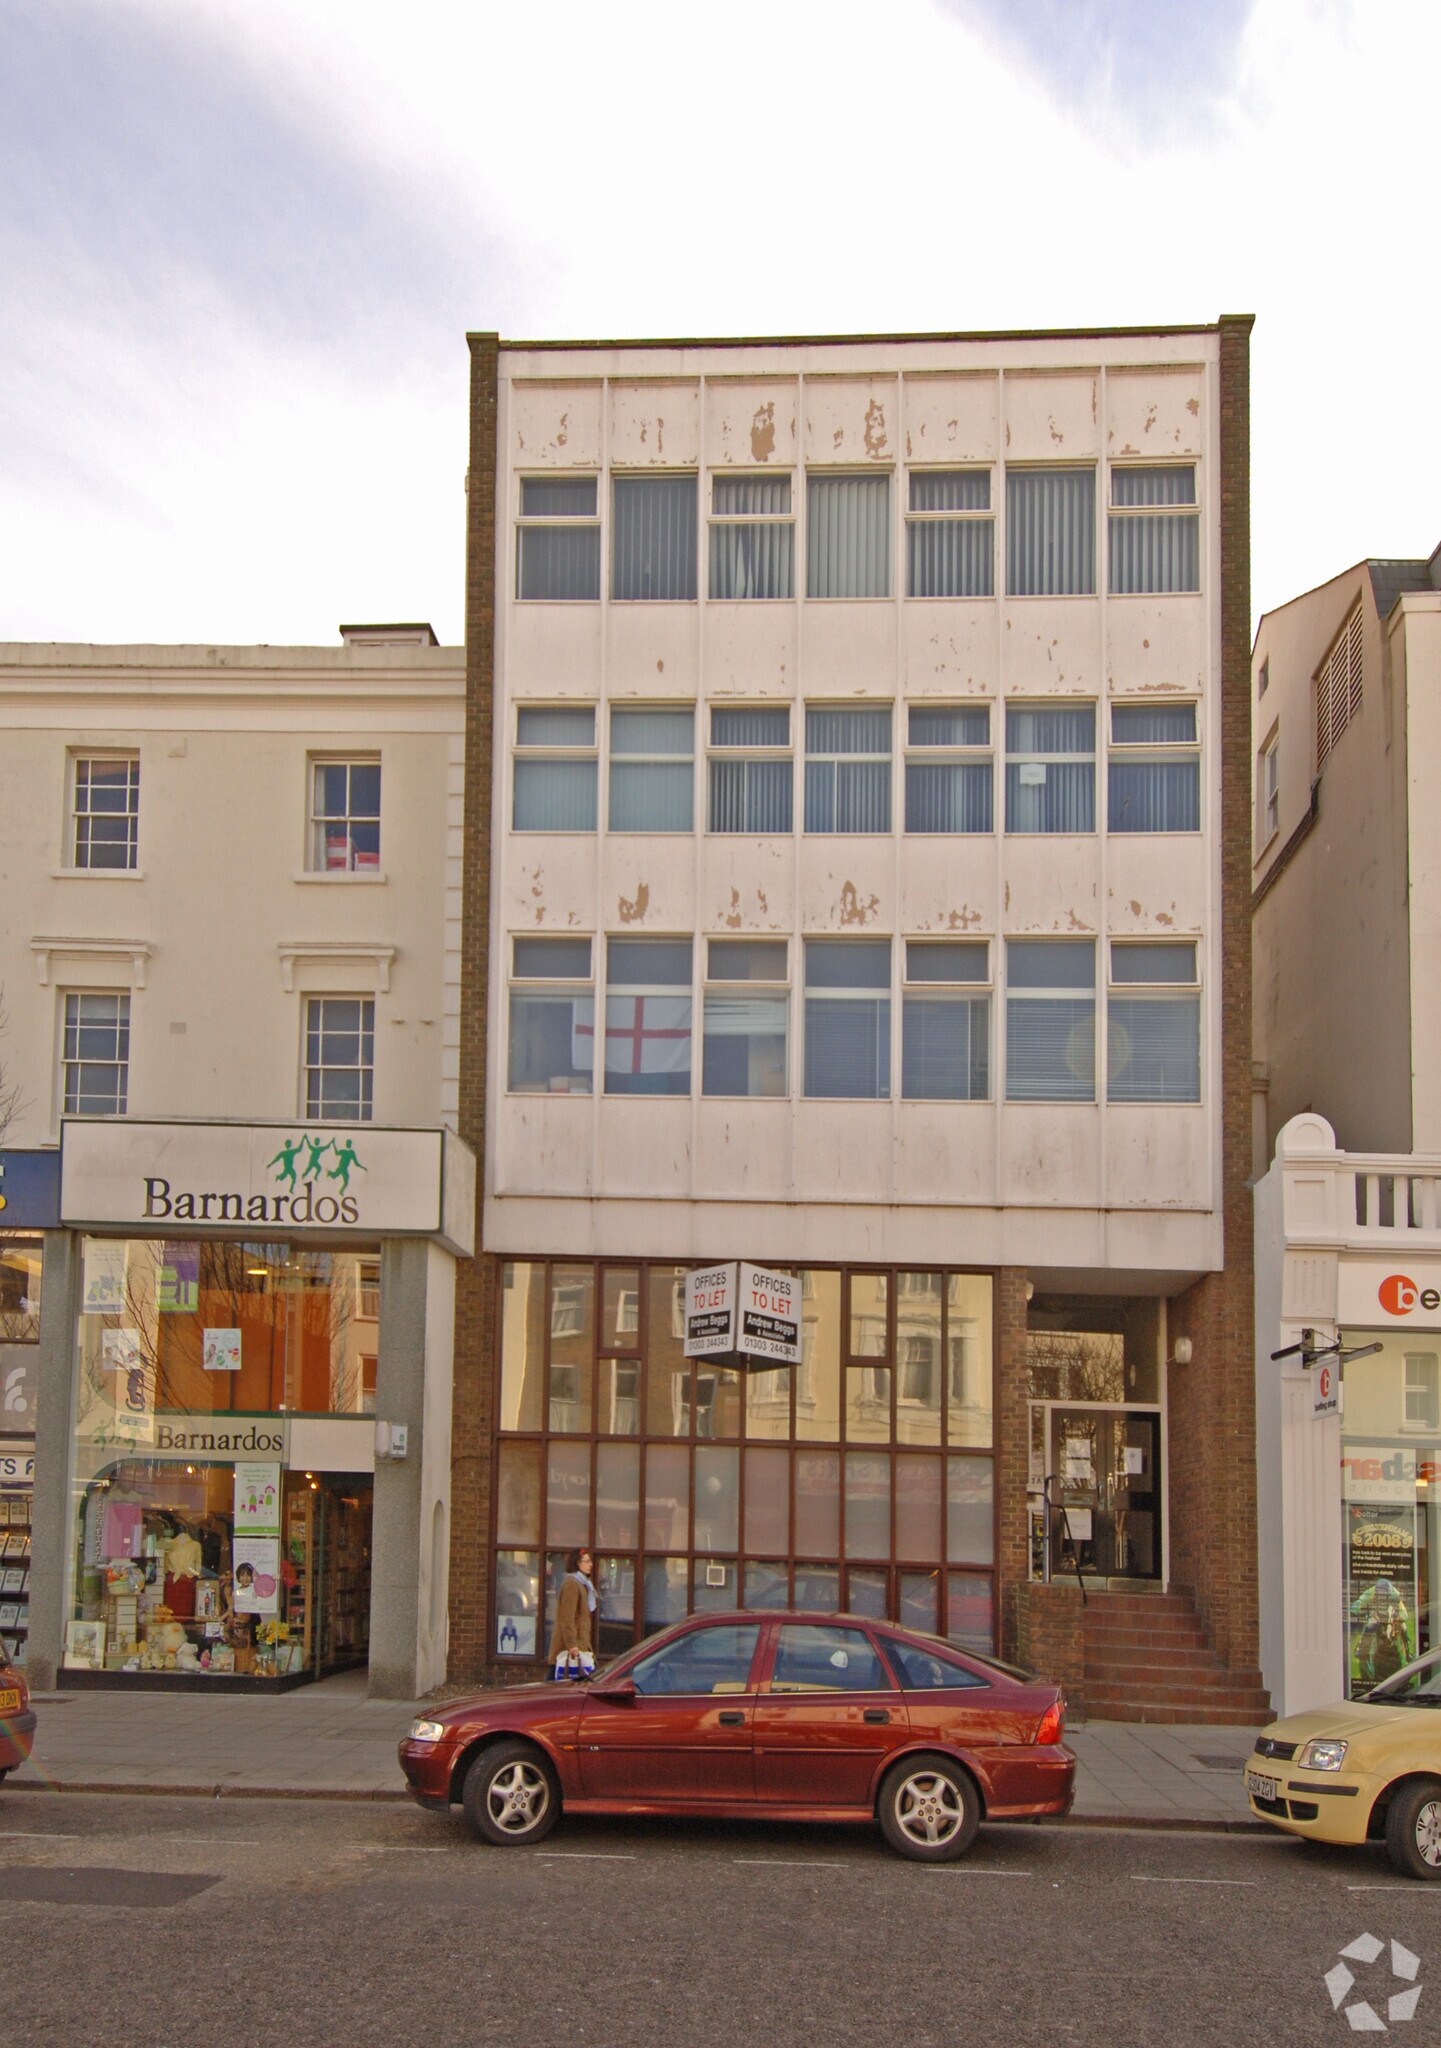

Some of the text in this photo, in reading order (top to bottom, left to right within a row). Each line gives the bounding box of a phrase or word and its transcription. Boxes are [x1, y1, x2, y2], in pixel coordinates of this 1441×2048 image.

[142, 1177, 359, 1224] Barnardos
[695, 1272, 726, 1290] OFFICES
[752, 1273, 791, 1296] OFFICES
[694, 1289, 726, 1310] TO LET
[752, 1290, 792, 1315] TO LET
[690, 1314, 729, 1328] Andrew Beggs
[746, 1314, 796, 1336] Andrew Beggs
[744, 1337, 797, 1358] 01303 244343
[156, 1424, 284, 1452] Barnardos
[1364, 1533, 1401, 1548] 2008
